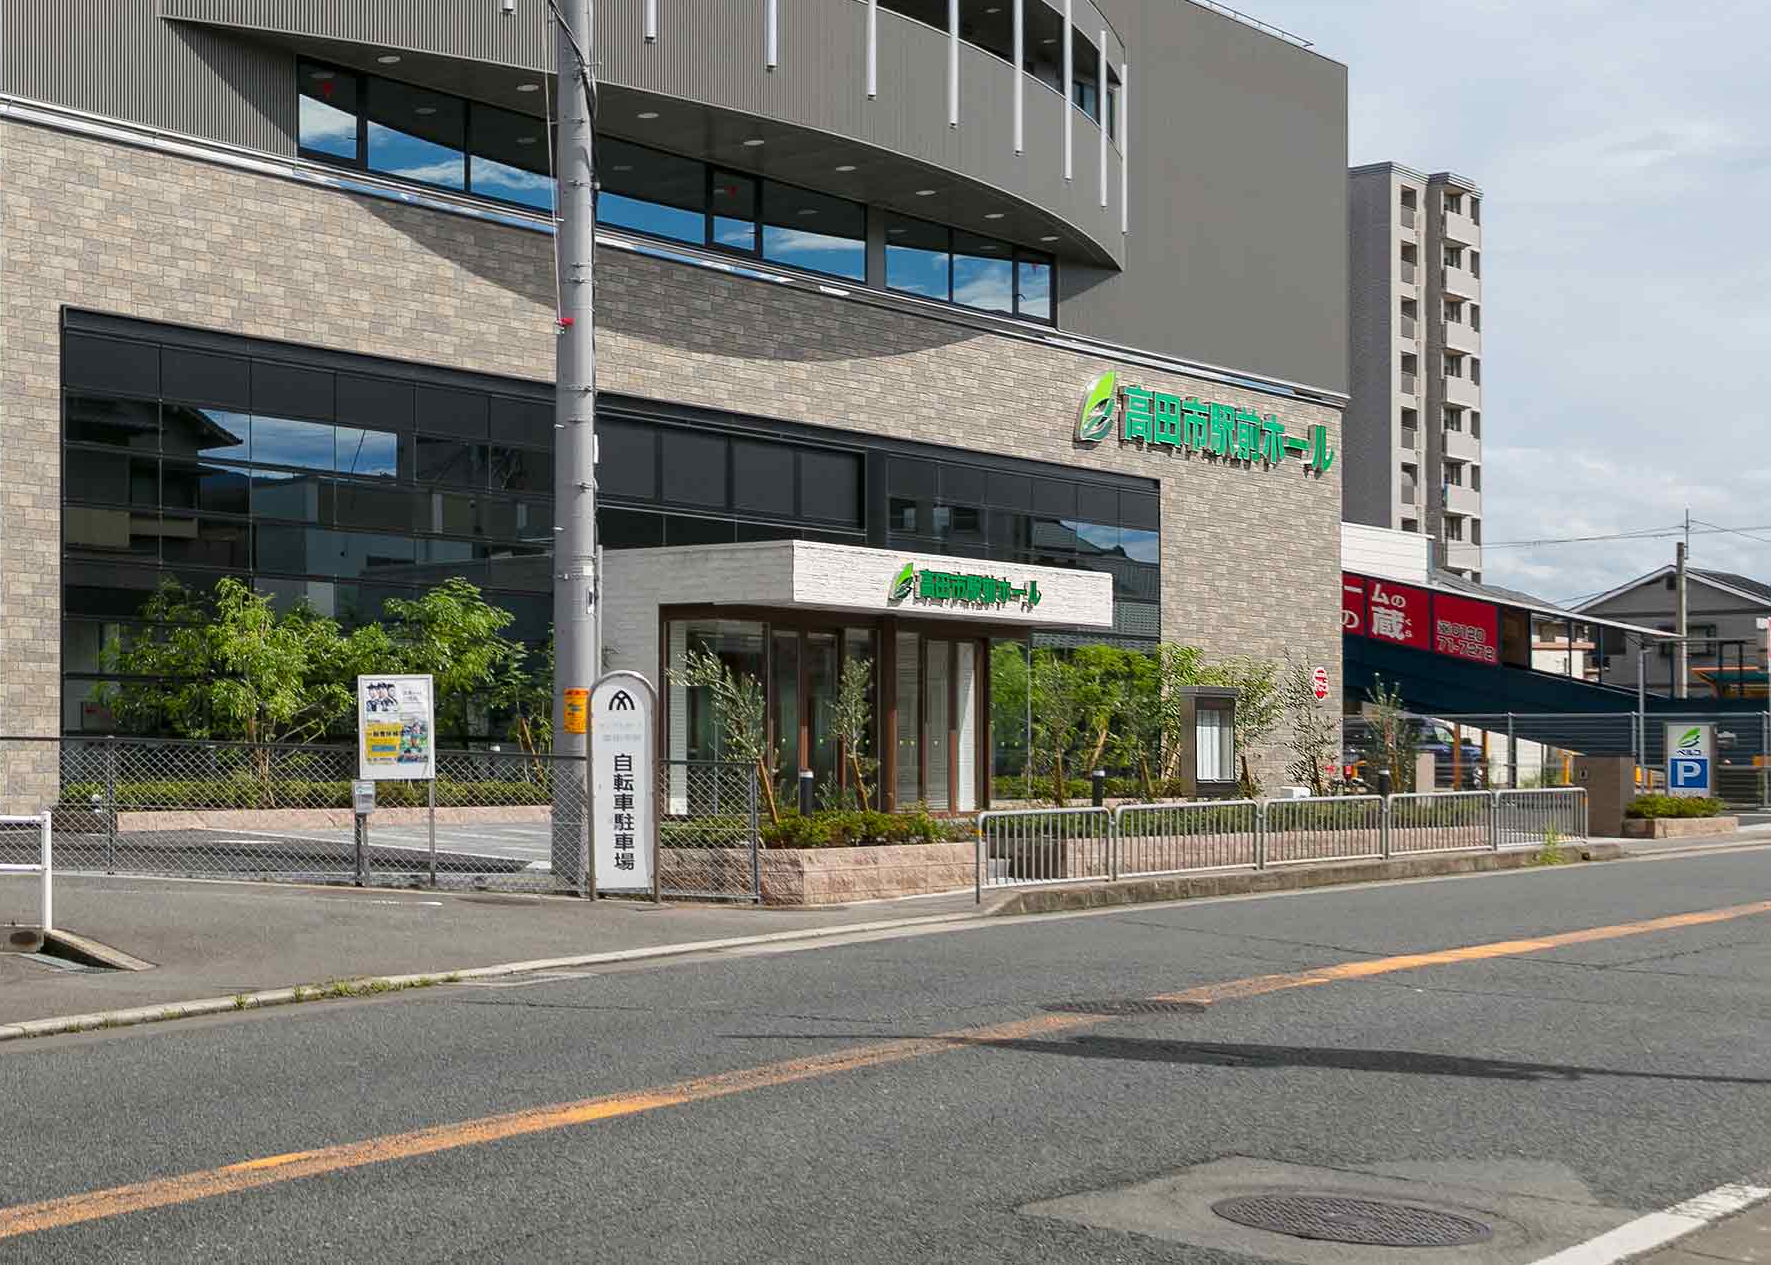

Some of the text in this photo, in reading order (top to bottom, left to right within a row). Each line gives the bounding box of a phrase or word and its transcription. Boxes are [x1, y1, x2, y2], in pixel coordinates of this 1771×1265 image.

[1123, 384, 1334, 472] 高田市駅前ホール
[613, 753, 635, 870] 自転車駐車場
[1677, 761, 1701, 785] P
